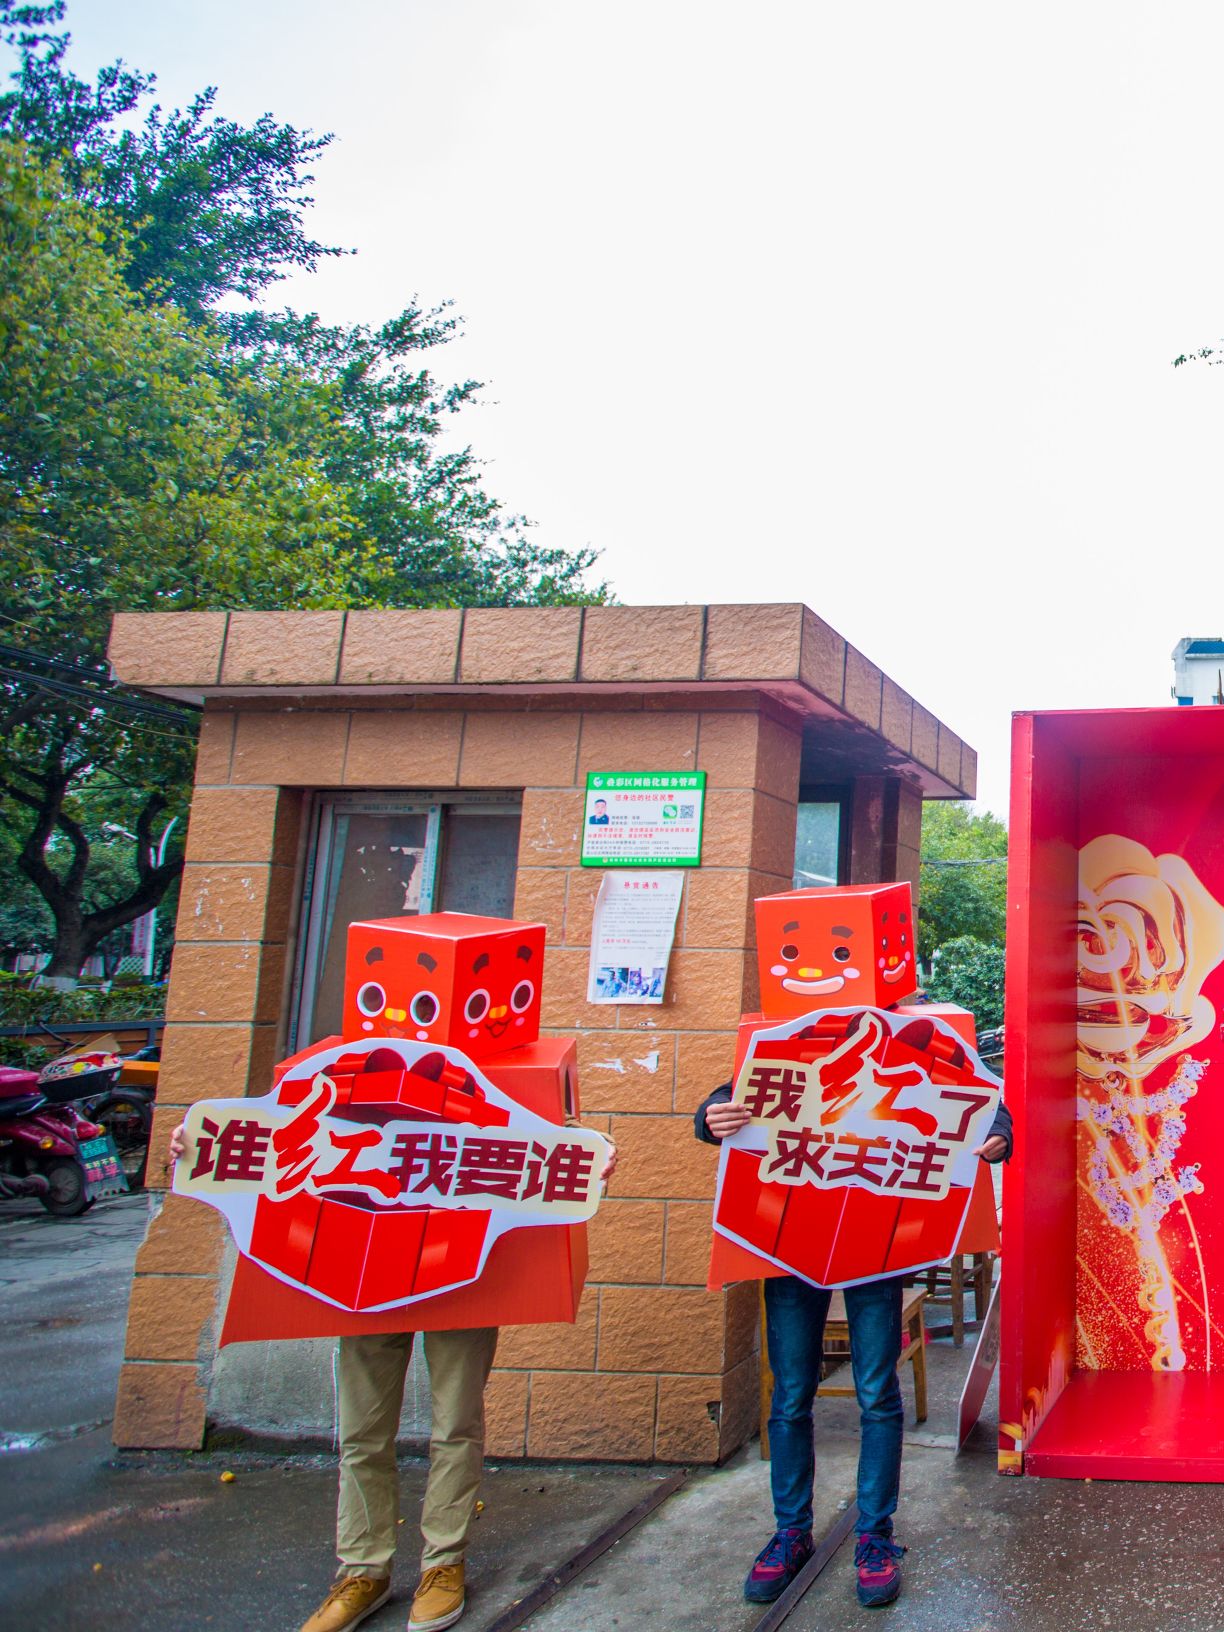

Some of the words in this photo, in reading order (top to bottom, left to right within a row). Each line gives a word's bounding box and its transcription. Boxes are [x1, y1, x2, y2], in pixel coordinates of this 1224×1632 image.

[744, 1020, 991, 1142] 我红了
[189, 1081, 596, 1204] 谁红我要谁
[768, 1126, 951, 1194] 求关注
